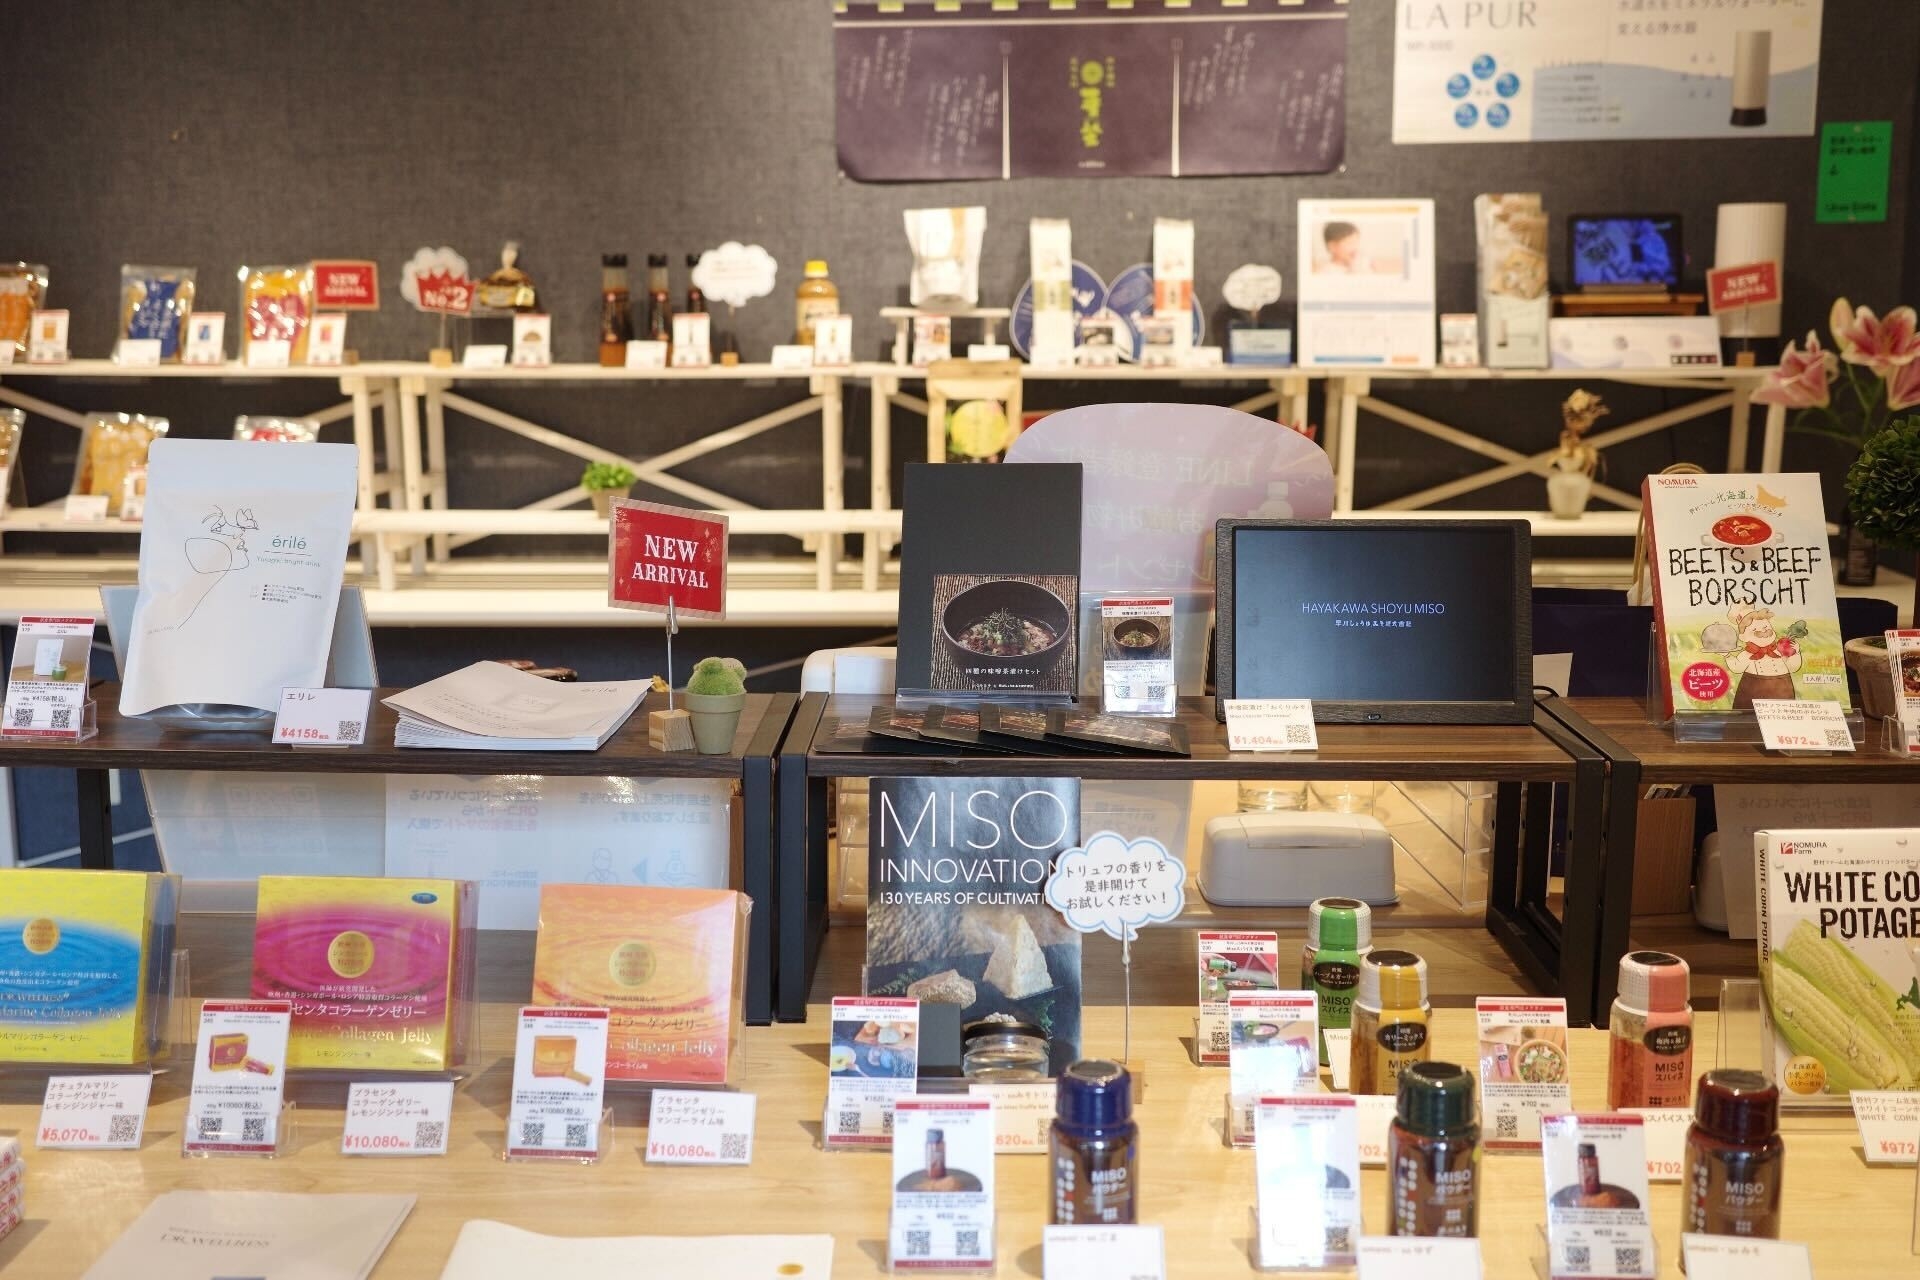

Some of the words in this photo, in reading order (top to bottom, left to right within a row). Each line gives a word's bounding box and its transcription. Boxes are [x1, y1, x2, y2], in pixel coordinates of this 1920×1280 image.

[272, 535, 307, 551] érilé
[644, 534, 700, 564] NEW
[1668, 547, 1745, 576] BEETS
[1749, 559, 1760, 572] &
[1762, 546, 1823, 574] BEEF
[631, 562, 709, 589] ARRIVAL
[1688, 577, 1811, 607] BORSCHT
[1302, 602, 1369, 614] HAYAKAWA
[1371, 602, 1412, 614] SHOYU
[1414, 602, 1445, 614] MISO
[1688, 668, 1721, 677] 北海道産
[1688, 678, 1724, 691] ビーツ
[286, 692, 316, 701] エリレ
[1777, 735, 1809, 745] ¥972
[879, 790, 1068, 850] MISO
[1065, 859, 1167, 878] トリュフの香りを
[1084, 877, 1149, 893] 是非開けて
[1784, 870, 1878, 903] WHITE
[1884, 870, 1920, 903] CO
[879, 891, 903, 905] 130
[905, 891, 951, 905] YEARS
[954, 891, 974, 905] OF
[1819, 907, 1920, 939] POTAGE
[1761, 921, 1769, 963] POTAGE
[1321, 995, 1350, 1006] MISO
[1321, 1005, 1350, 1014] スパイス
[330, 1024, 394, 1042] Collagen
[401, 1026, 432, 1045] Jelly
[1388, 1059, 1418, 1068] MISO
[1655, 1062, 1685, 1072] MISO
[1655, 1072, 1684, 1081] スパイス
[50, 1081, 120, 1090] ナチュラルマリン
[48, 1091, 117, 1100] コラーゲンゼリー
[354, 1088, 397, 1097] プラセンタ
[45, 1101, 124, 1110] レモンジンジャー味
[353, 1099, 422, 1107] コラーゲンゼリー
[657, 1096, 700, 1104] プラセンタ
[351, 1107, 429, 1117] レモンジンジャー味
[657, 1106, 725, 1114] コラーゲンゼリー
[656, 1116, 724, 1126] マンゴーライム味
[42, 1127, 88, 1141] ¥5,070
[345, 1135, 399, 1148] ¥10,080
[1879, 1140, 1917, 1155] ¥972
[651, 1142, 704, 1155] ¥10,080
[1359, 1144, 1380, 1156] 02
[1091, 1167, 1127, 1184] MISO
[1435, 1168, 1472, 1185] MISO
[1725, 1181, 1765, 1195] MISO
